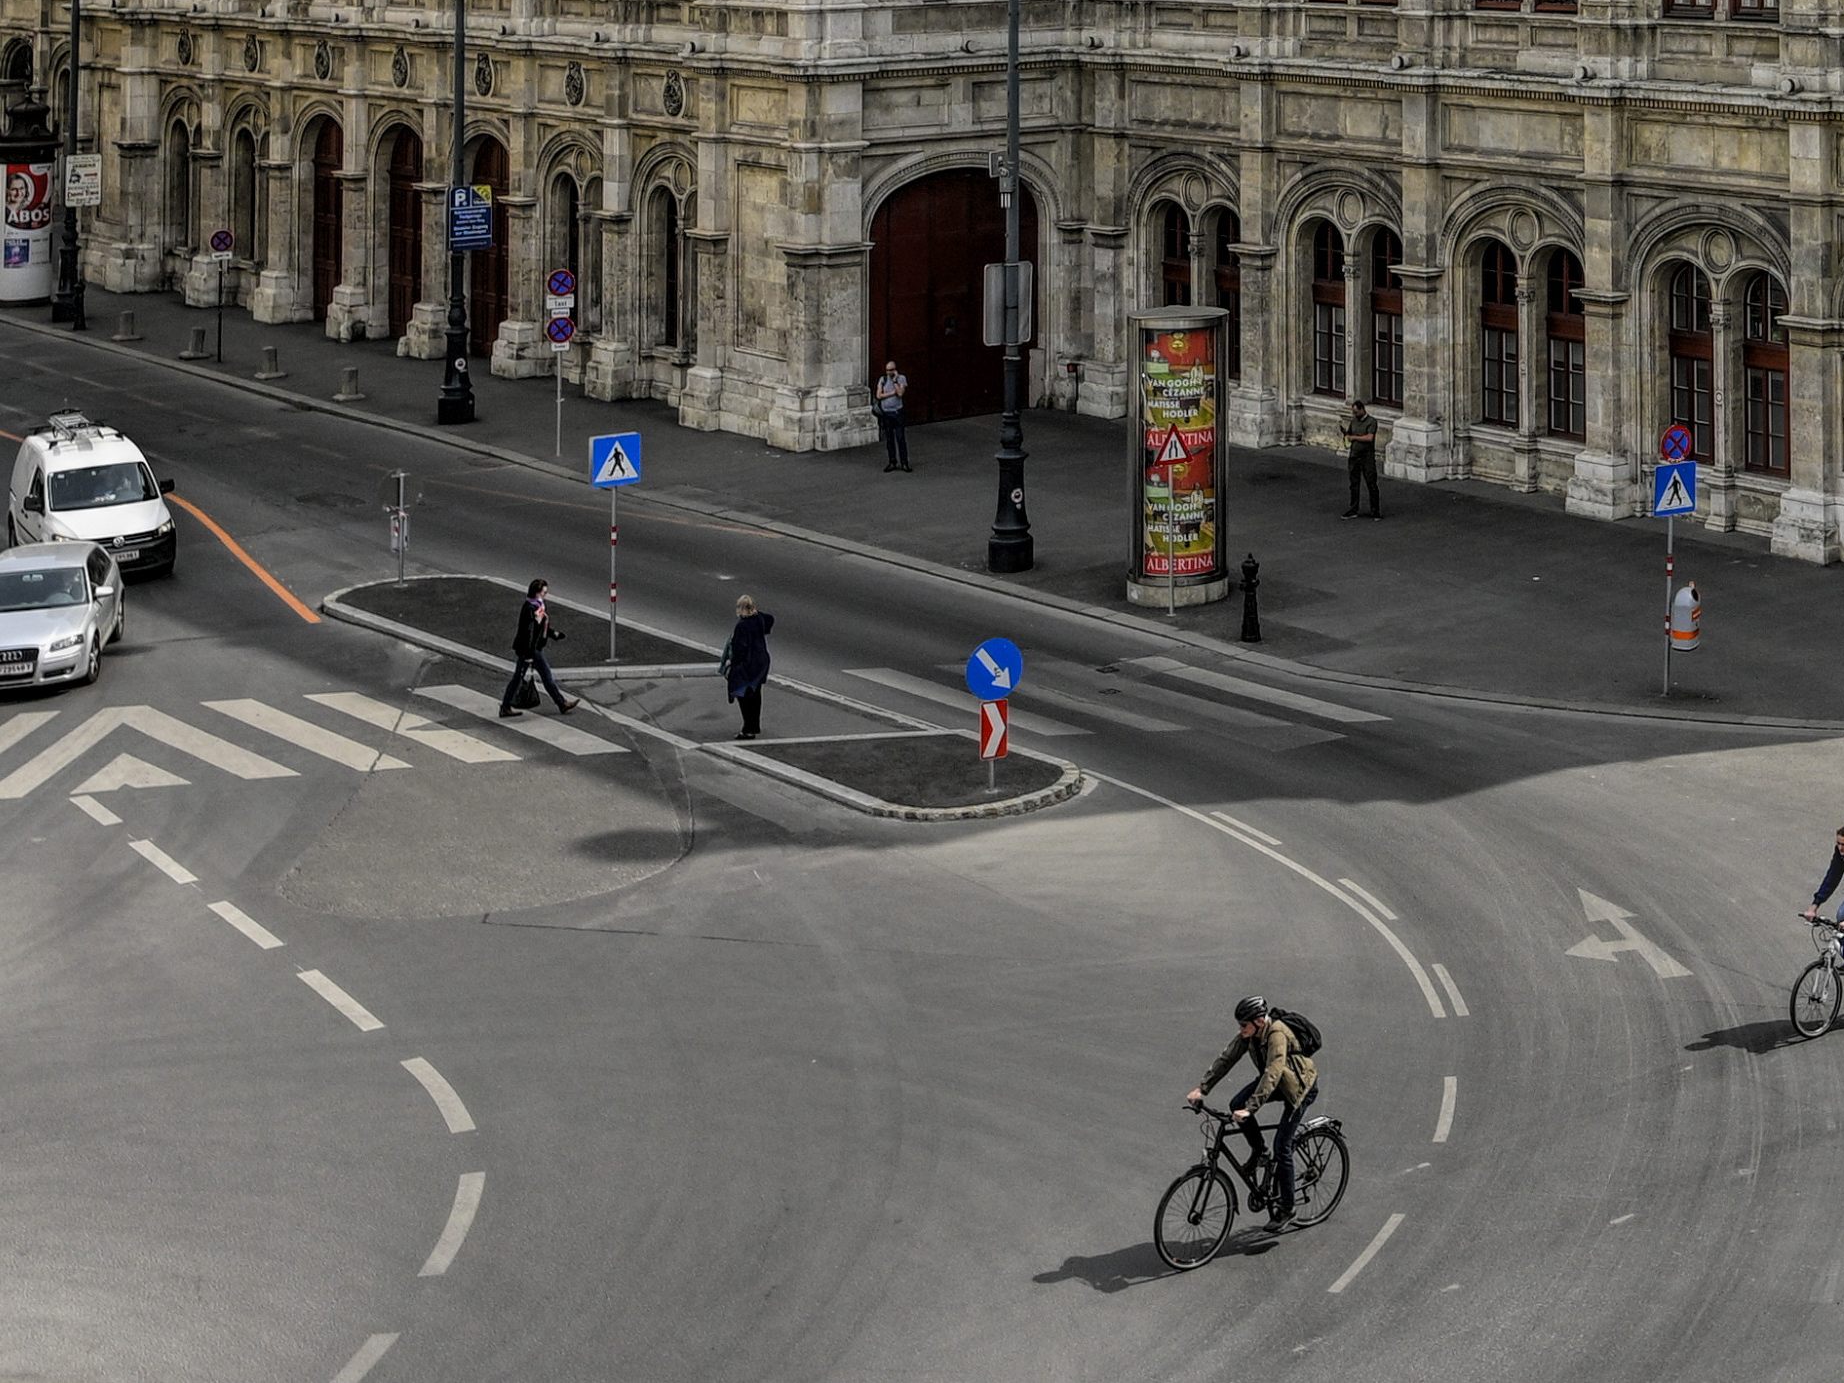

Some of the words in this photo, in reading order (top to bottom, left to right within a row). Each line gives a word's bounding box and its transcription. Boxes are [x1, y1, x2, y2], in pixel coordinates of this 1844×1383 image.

[8, 208, 50, 223] ABOS
[1147, 378, 1166, 387] VAN
[1167, 379, 1197, 388] GOGH
[1162, 409, 1199, 419] HODLER
[1147, 431, 1213, 445] ALTINA
[1162, 510, 1204, 521] CZANNE
